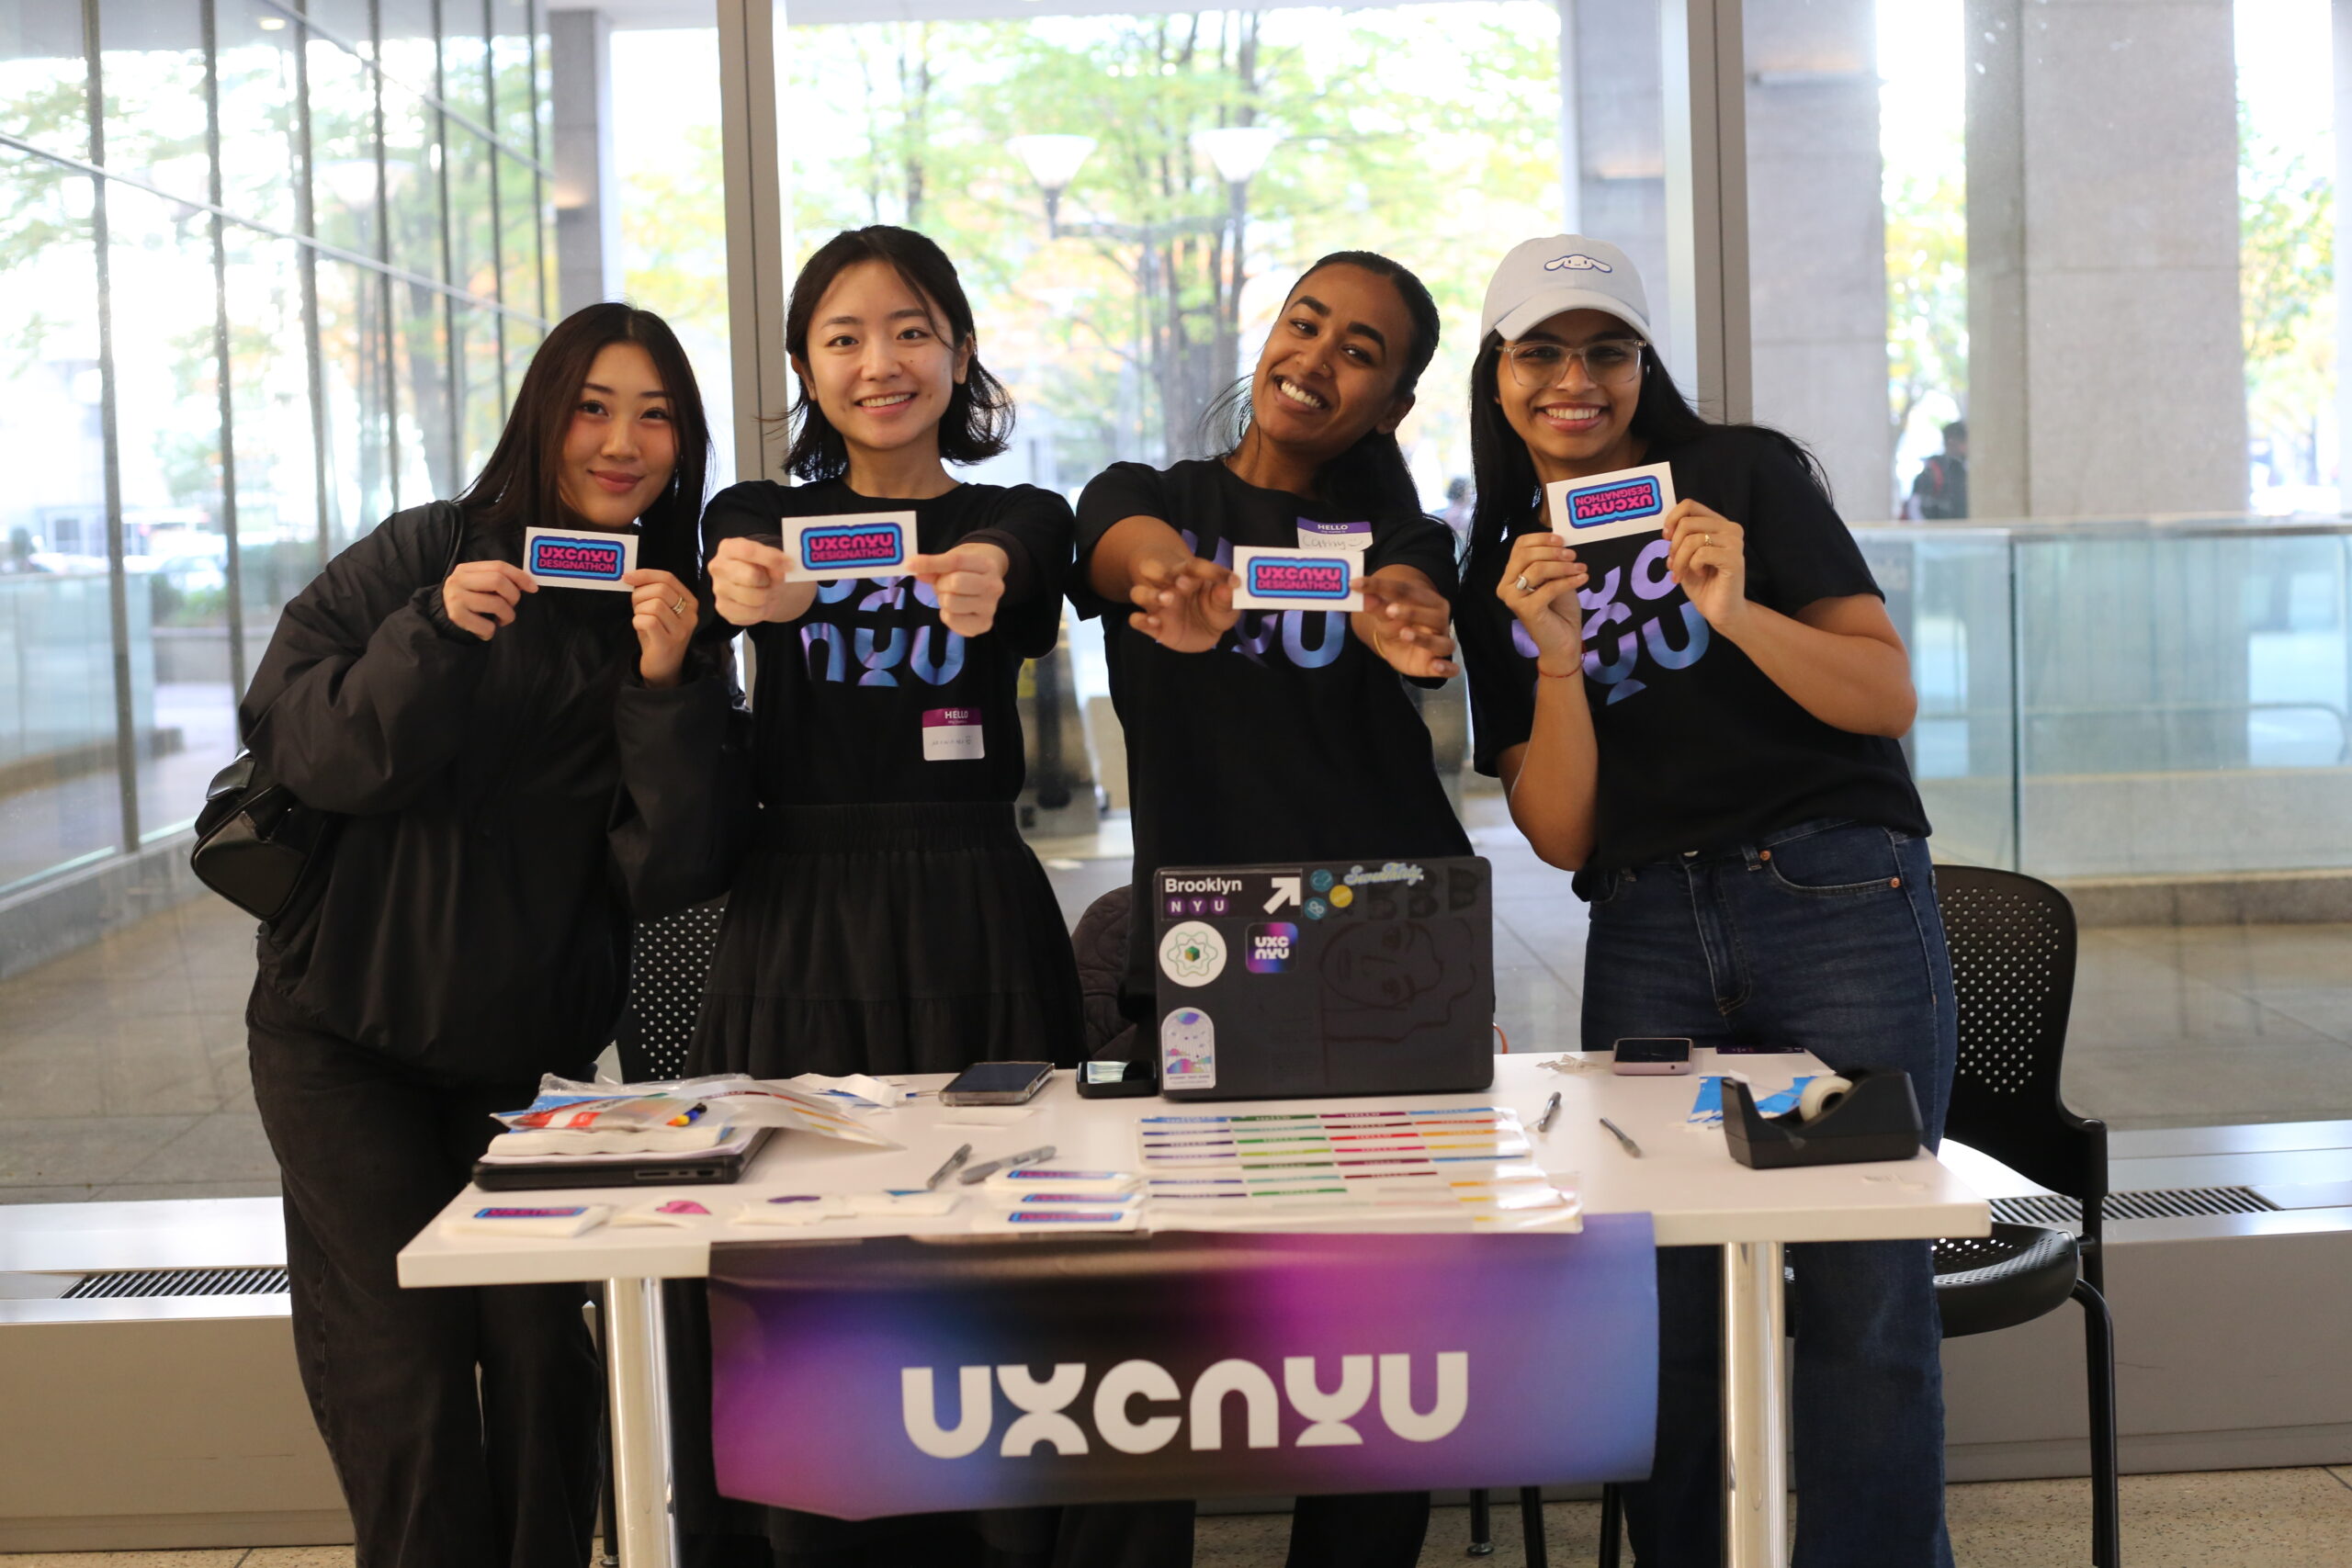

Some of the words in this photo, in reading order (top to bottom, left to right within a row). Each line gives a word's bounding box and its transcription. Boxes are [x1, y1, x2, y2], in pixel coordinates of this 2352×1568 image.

[1576, 484, 1652, 506] DESIGNATHON
[810, 547, 894, 561] DESIGNATHON
[538, 558, 616, 572] DESIGNATHON
[1257, 580, 1341, 591] DESIGNATHON
[944, 710, 969, 719] HELLO
[1165, 877, 1242, 895] Brooklyn
[1255, 936, 1290, 947] UXC
[901, 1351, 1468, 1459] UXCNYU
